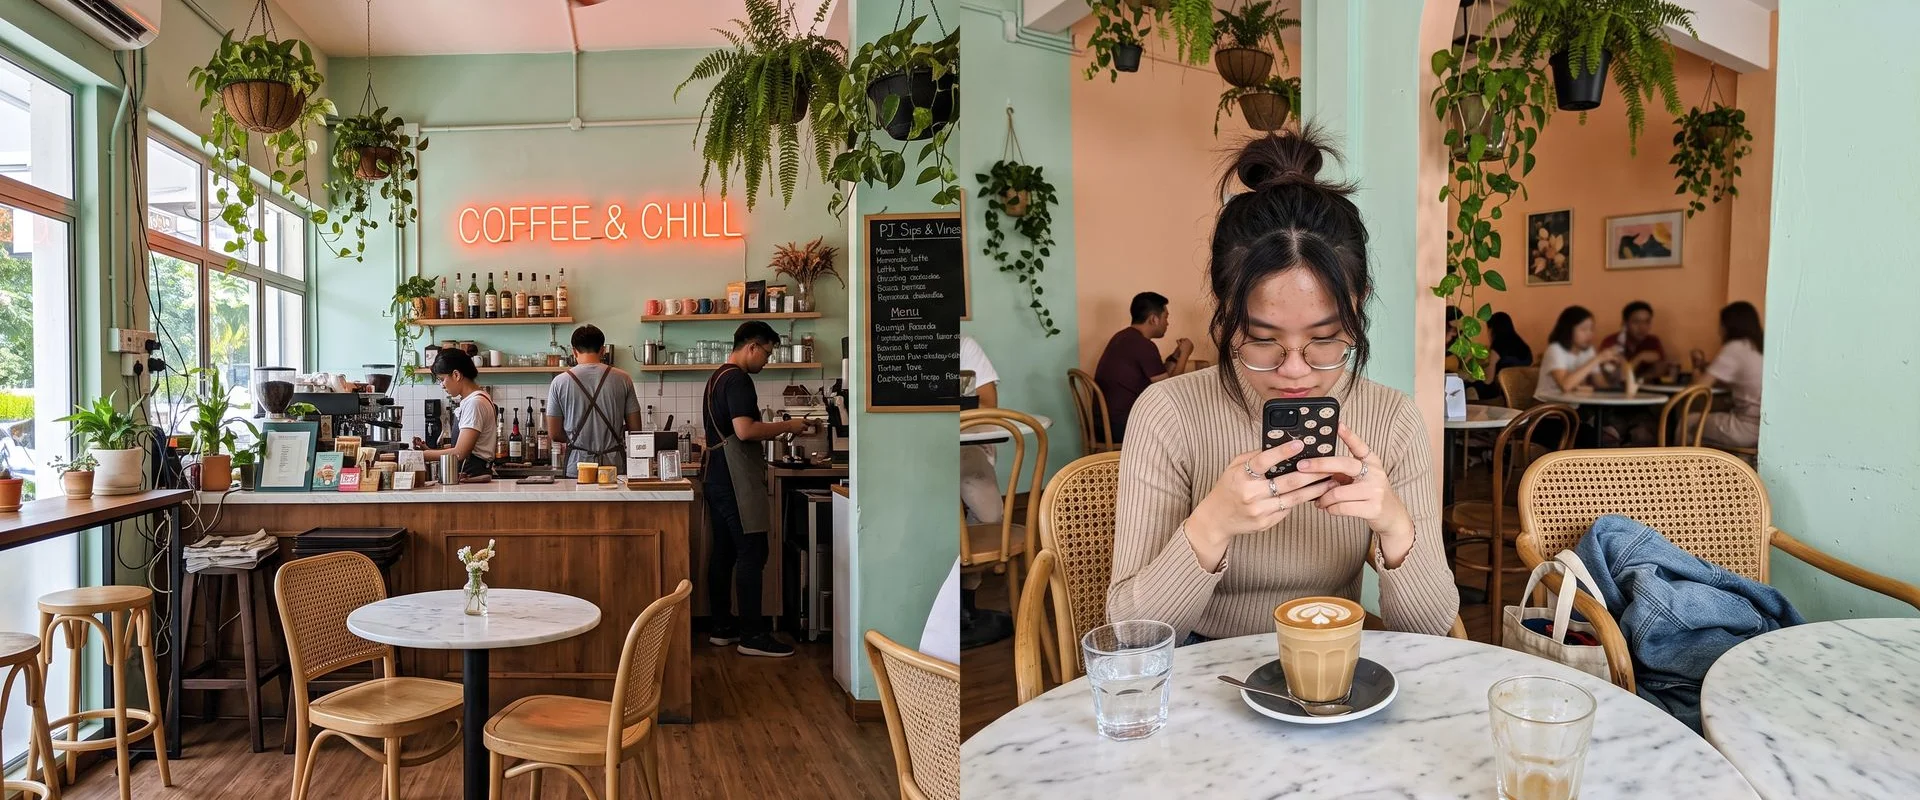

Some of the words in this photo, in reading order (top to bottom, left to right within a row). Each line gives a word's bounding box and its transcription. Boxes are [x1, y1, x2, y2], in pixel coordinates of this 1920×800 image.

[458, 205, 592, 244] COFFEE
[604, 204, 628, 241] &
[641, 201, 743, 240] CHILL
[879, 223, 896, 238] PJ
[900, 222, 922, 241] Sips
[924, 223, 933, 235] &
[935, 222, 961, 235] Vines
[891, 307, 920, 318] Menu
